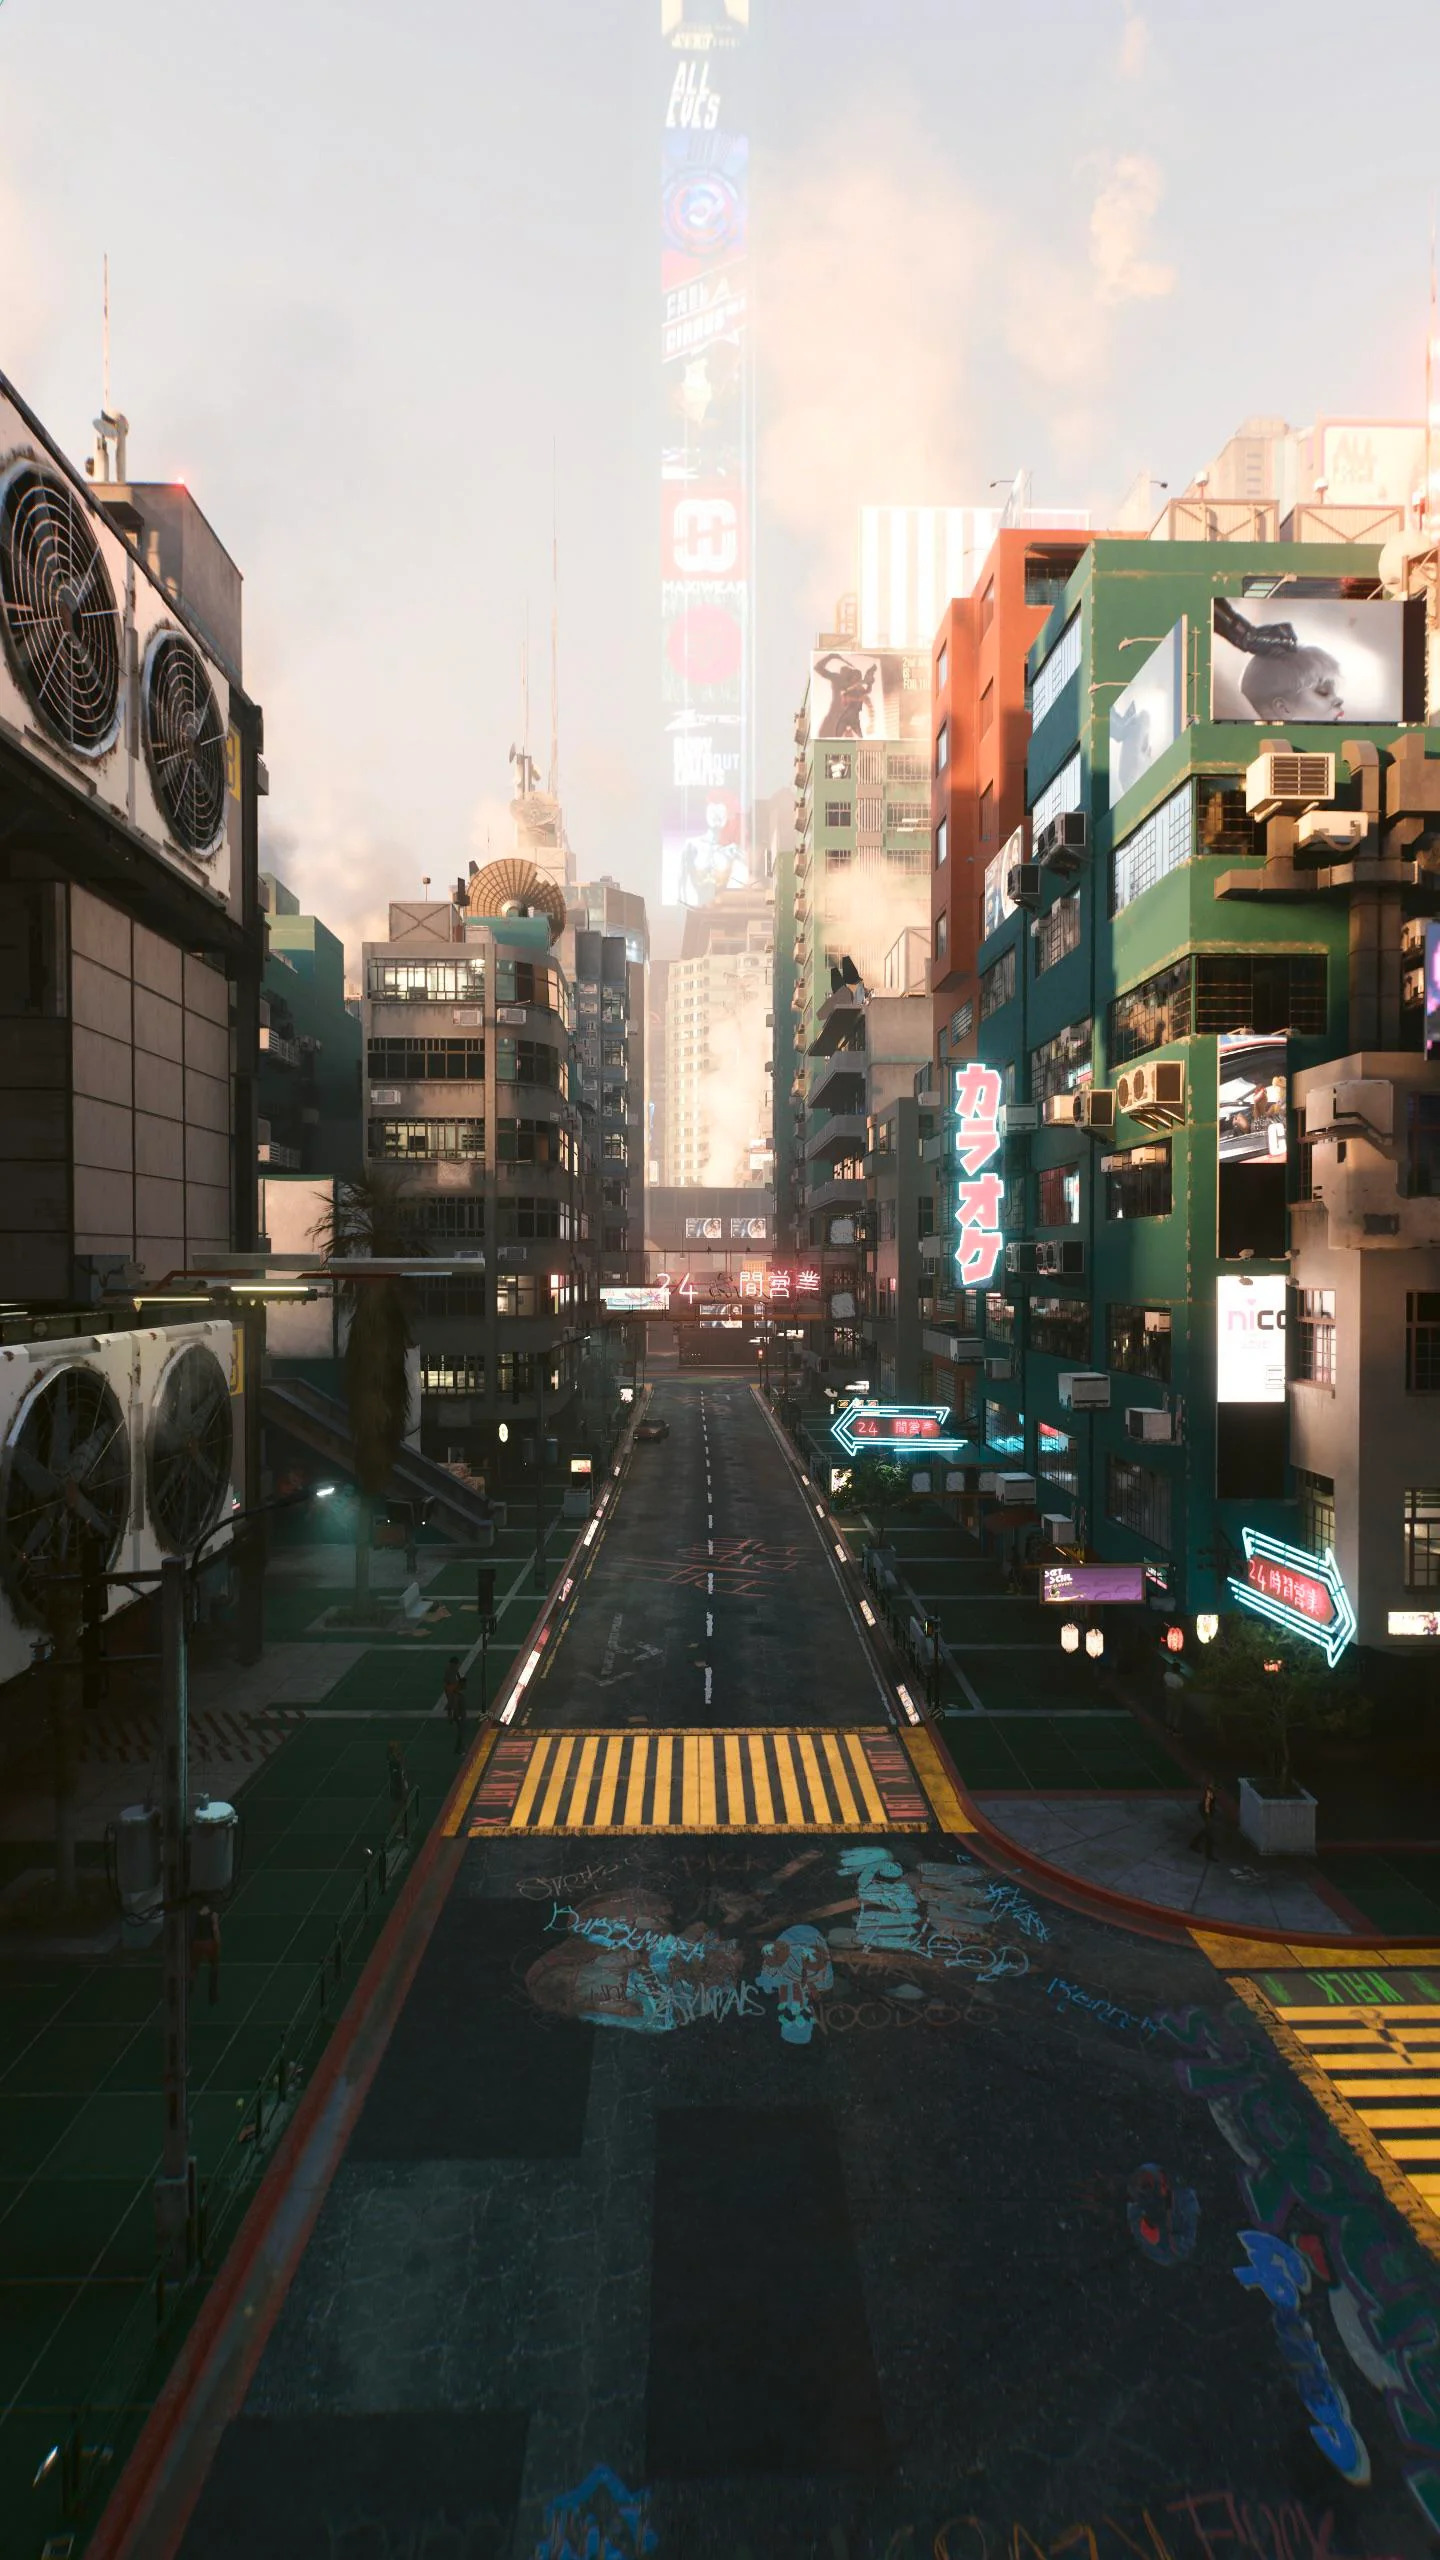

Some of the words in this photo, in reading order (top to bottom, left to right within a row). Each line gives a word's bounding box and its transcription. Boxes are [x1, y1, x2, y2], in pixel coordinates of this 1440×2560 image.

[955, 1063, 1004, 1285] カラオケ
[1306, 1971, 1405, 2003] WALK
